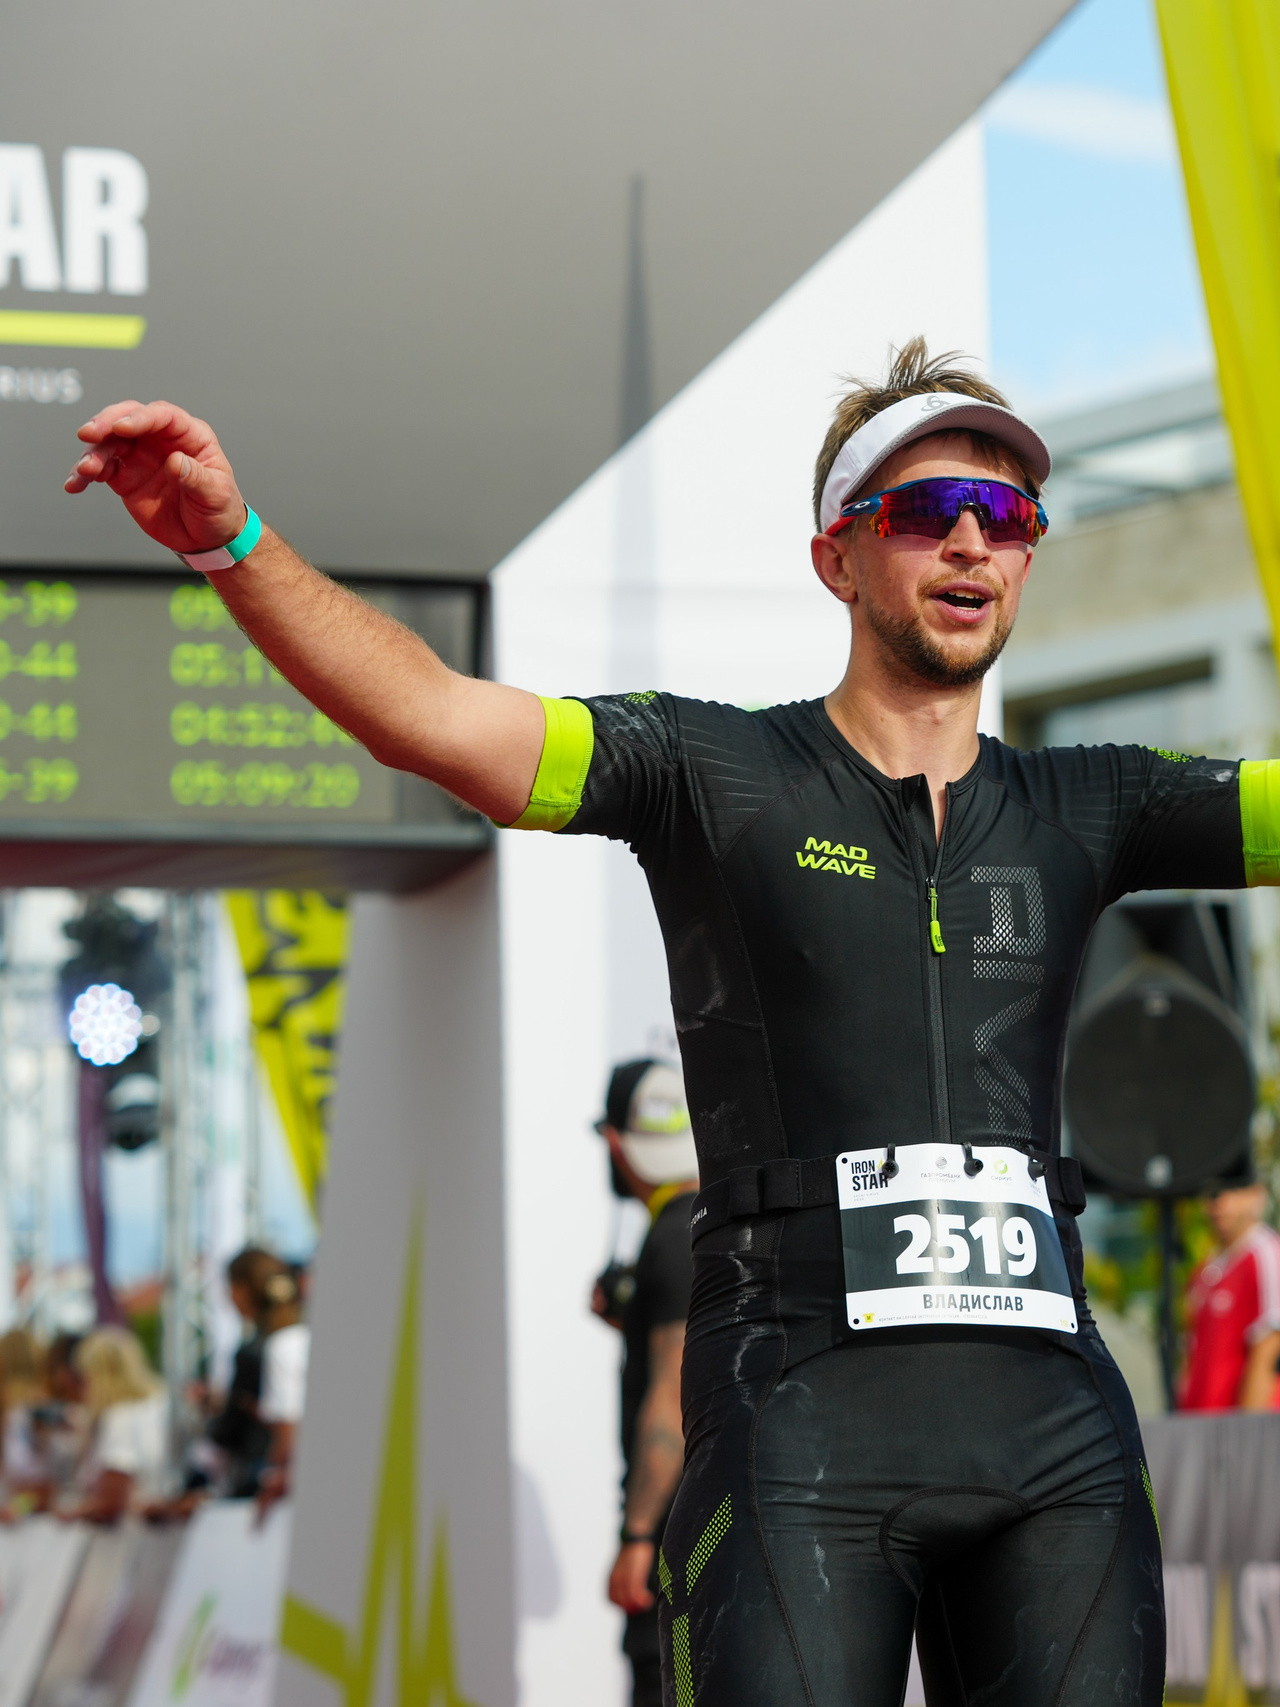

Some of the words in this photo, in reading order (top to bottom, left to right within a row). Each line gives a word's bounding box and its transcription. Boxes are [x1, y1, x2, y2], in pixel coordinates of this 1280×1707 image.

[804, 836, 869, 861] MAD
[796, 851, 876, 880] WAVE
[851, 1159, 876, 1174] IRON
[852, 1172, 889, 1191] STAR
[893, 1213, 1037, 1277] 2519
[922, 1293, 1024, 1312] ВЛАДИСЛАВ
